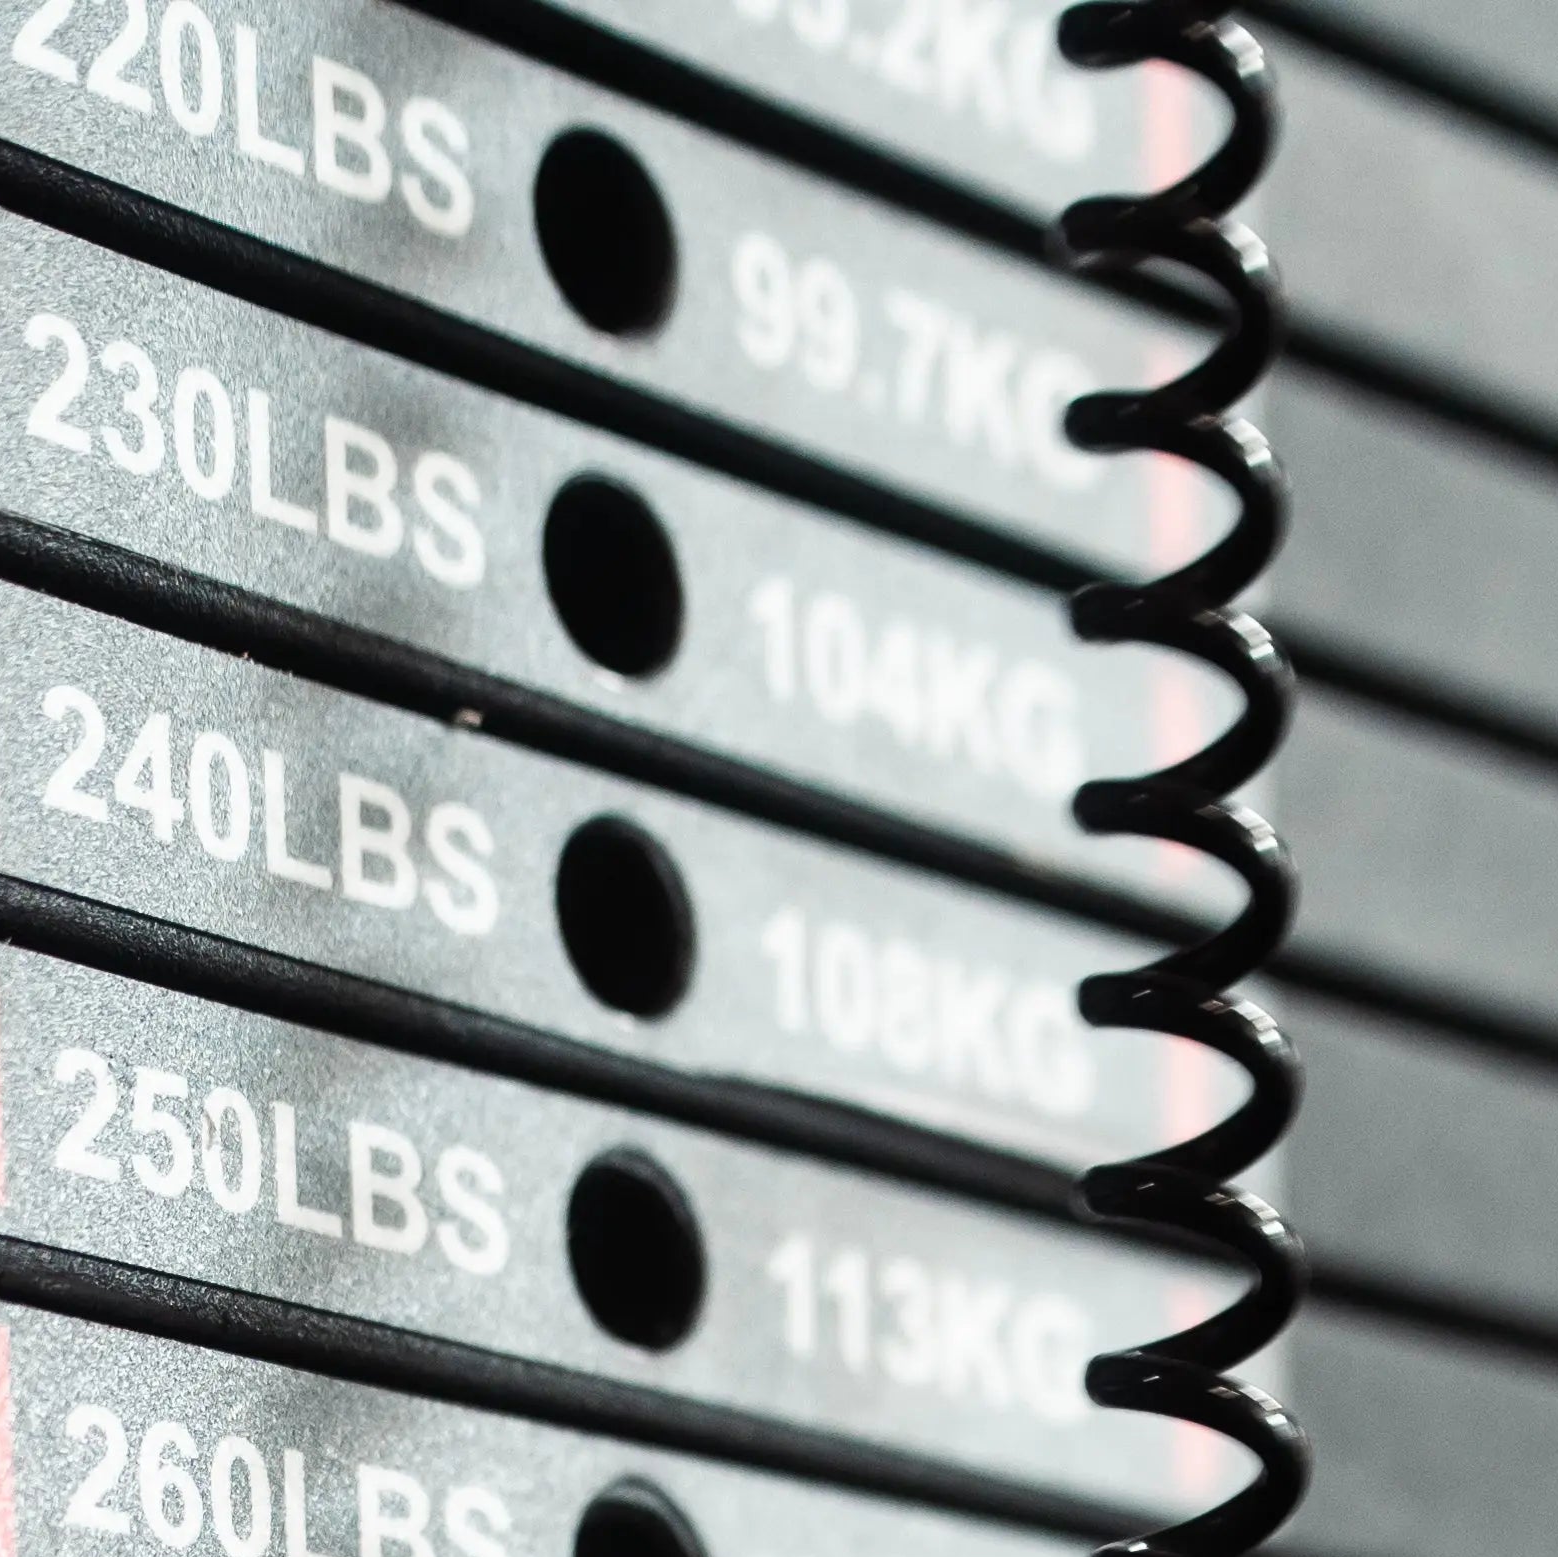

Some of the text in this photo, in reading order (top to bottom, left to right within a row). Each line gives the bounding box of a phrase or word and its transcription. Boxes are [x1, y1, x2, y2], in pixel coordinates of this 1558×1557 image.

[24, 312, 1085, 796] 230LBS 104KG
[731, 232, 1111, 490] 99.7KG
[41, 684, 1097, 1116] 240LBS 108KG
[51, 1048, 1093, 1424] 250LBS 113KG
